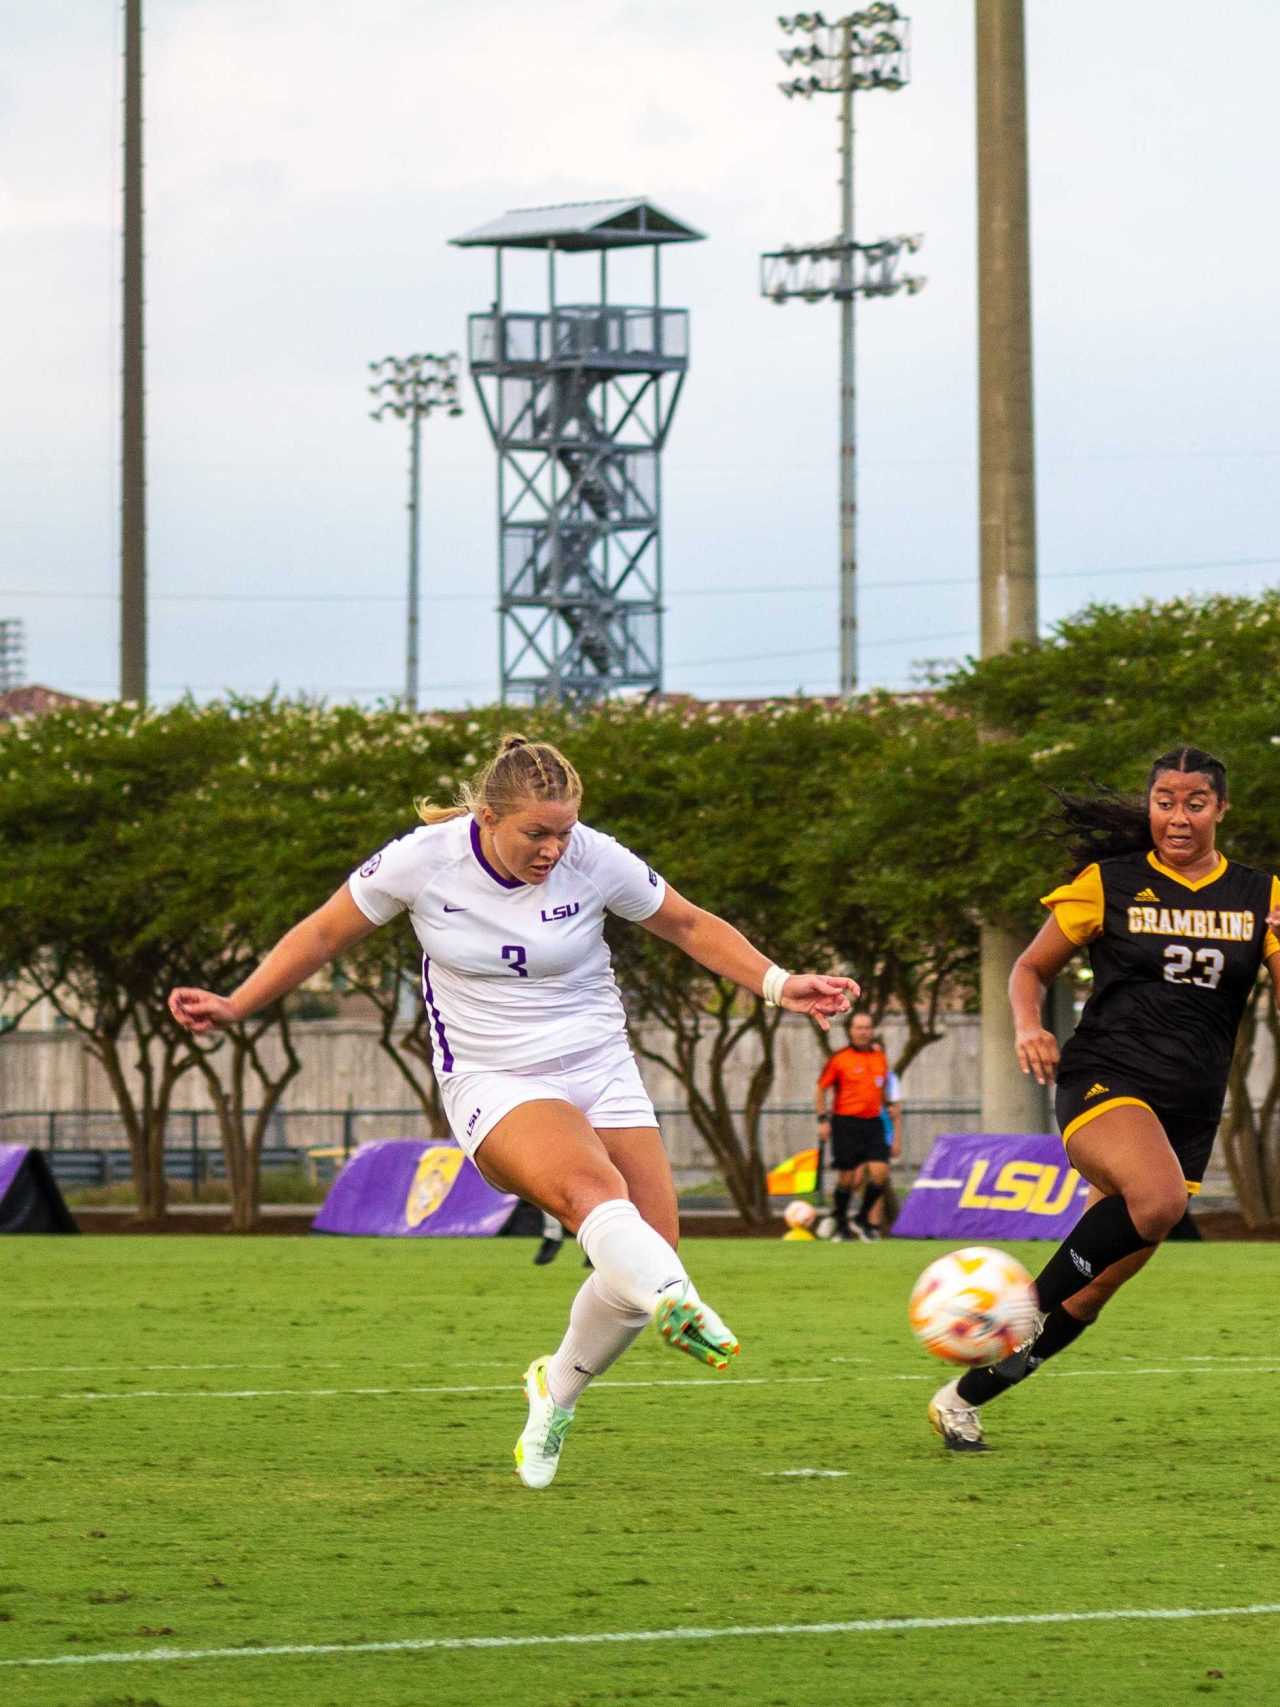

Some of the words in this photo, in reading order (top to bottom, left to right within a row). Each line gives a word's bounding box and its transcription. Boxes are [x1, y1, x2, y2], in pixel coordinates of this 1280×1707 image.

[541, 902, 579, 922] LSU
[1128, 907, 1254, 941] GRAMBLING
[502, 945, 528, 977] 3
[1164, 944, 1224, 989] 23
[466, 1107, 481, 1137] LSU
[959, 1159, 1081, 1215] LSU
